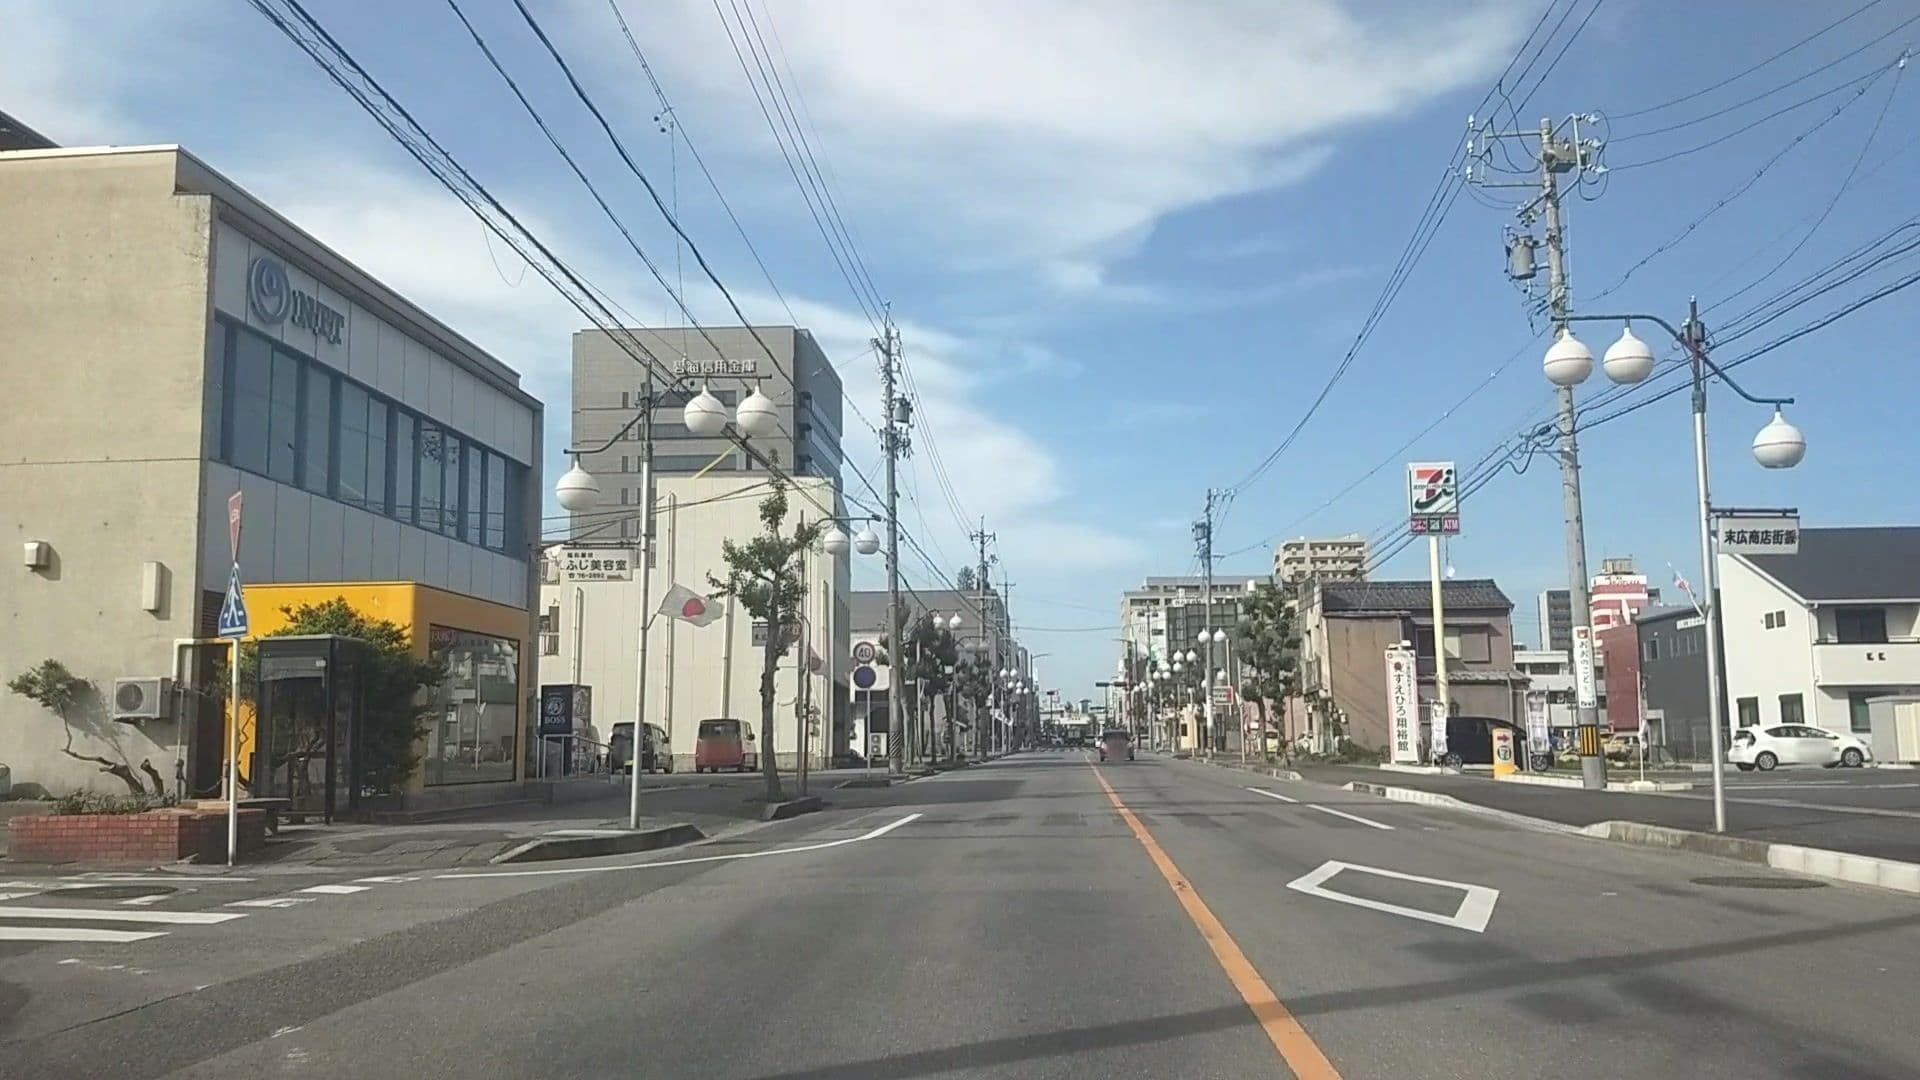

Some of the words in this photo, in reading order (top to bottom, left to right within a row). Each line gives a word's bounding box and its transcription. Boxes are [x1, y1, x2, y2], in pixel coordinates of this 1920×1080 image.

[1443, 519, 1459, 530] ATM
[566, 559, 627, 571] ふじ美容室
